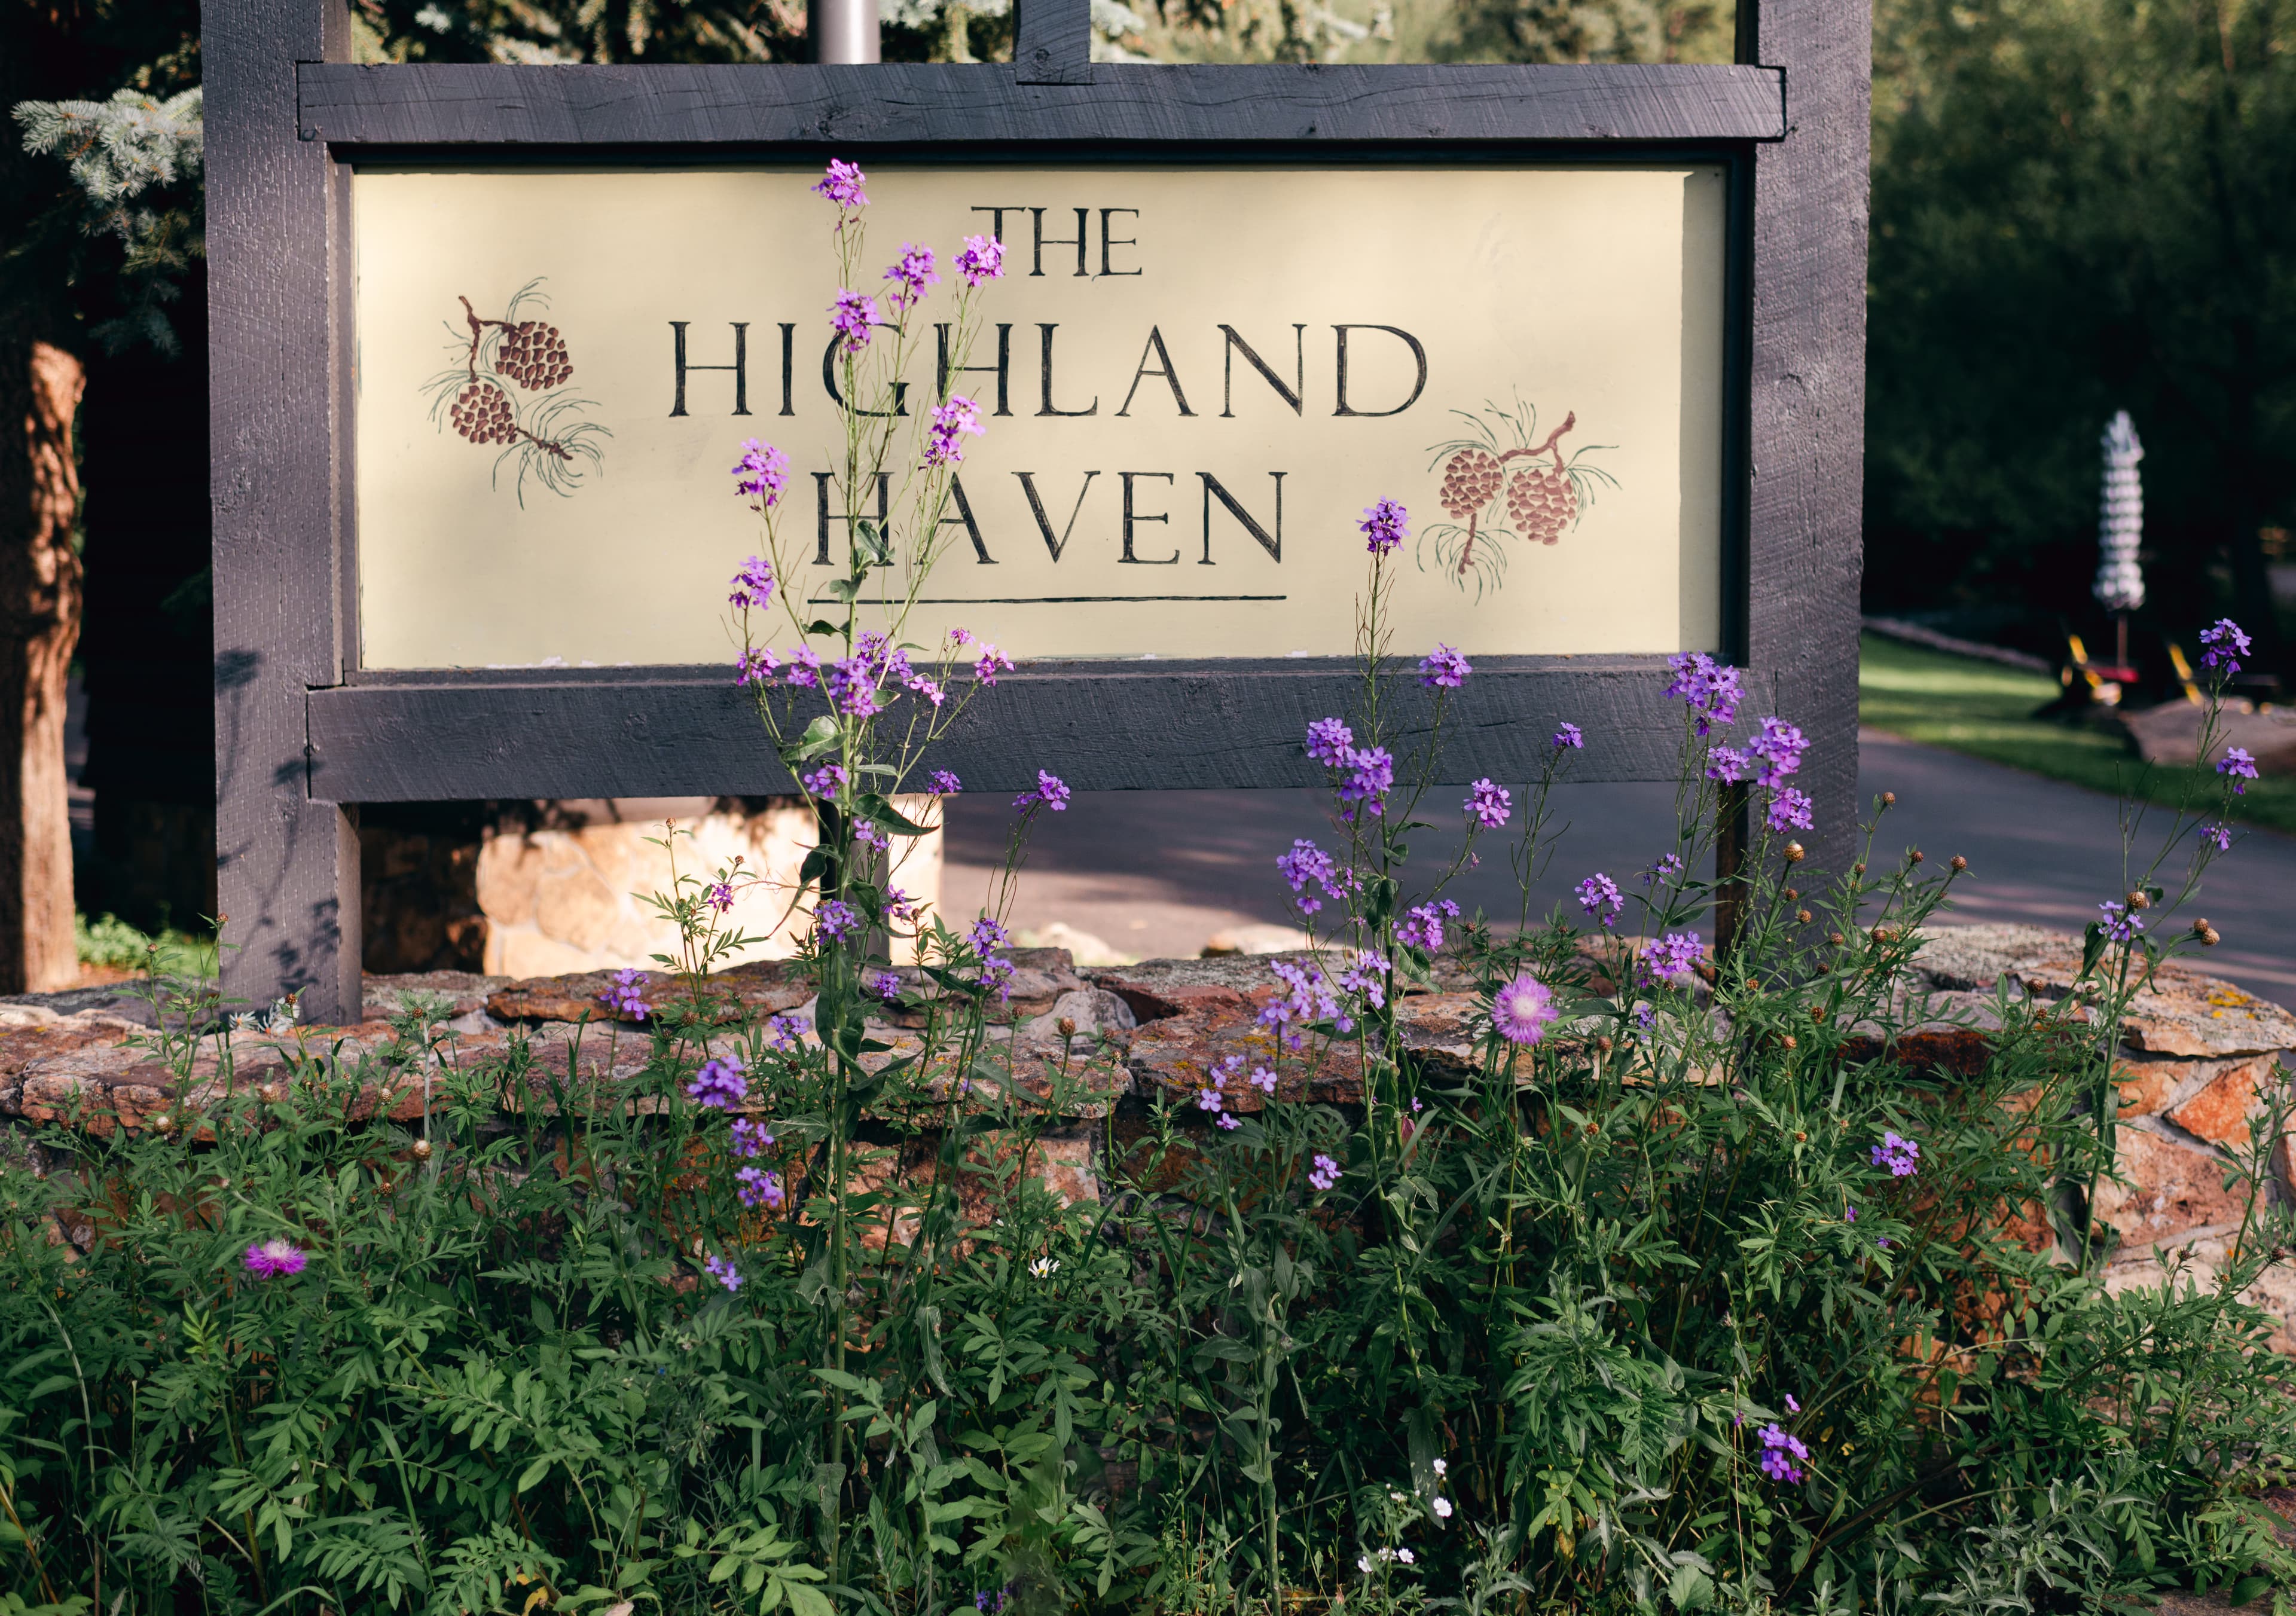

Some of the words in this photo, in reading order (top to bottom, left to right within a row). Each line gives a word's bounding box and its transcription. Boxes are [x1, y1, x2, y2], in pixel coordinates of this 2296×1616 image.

[971, 206, 1143, 278] THE
[668, 322, 1428, 417] HIGHLAND
[811, 471, 1288, 565] HAVEN
